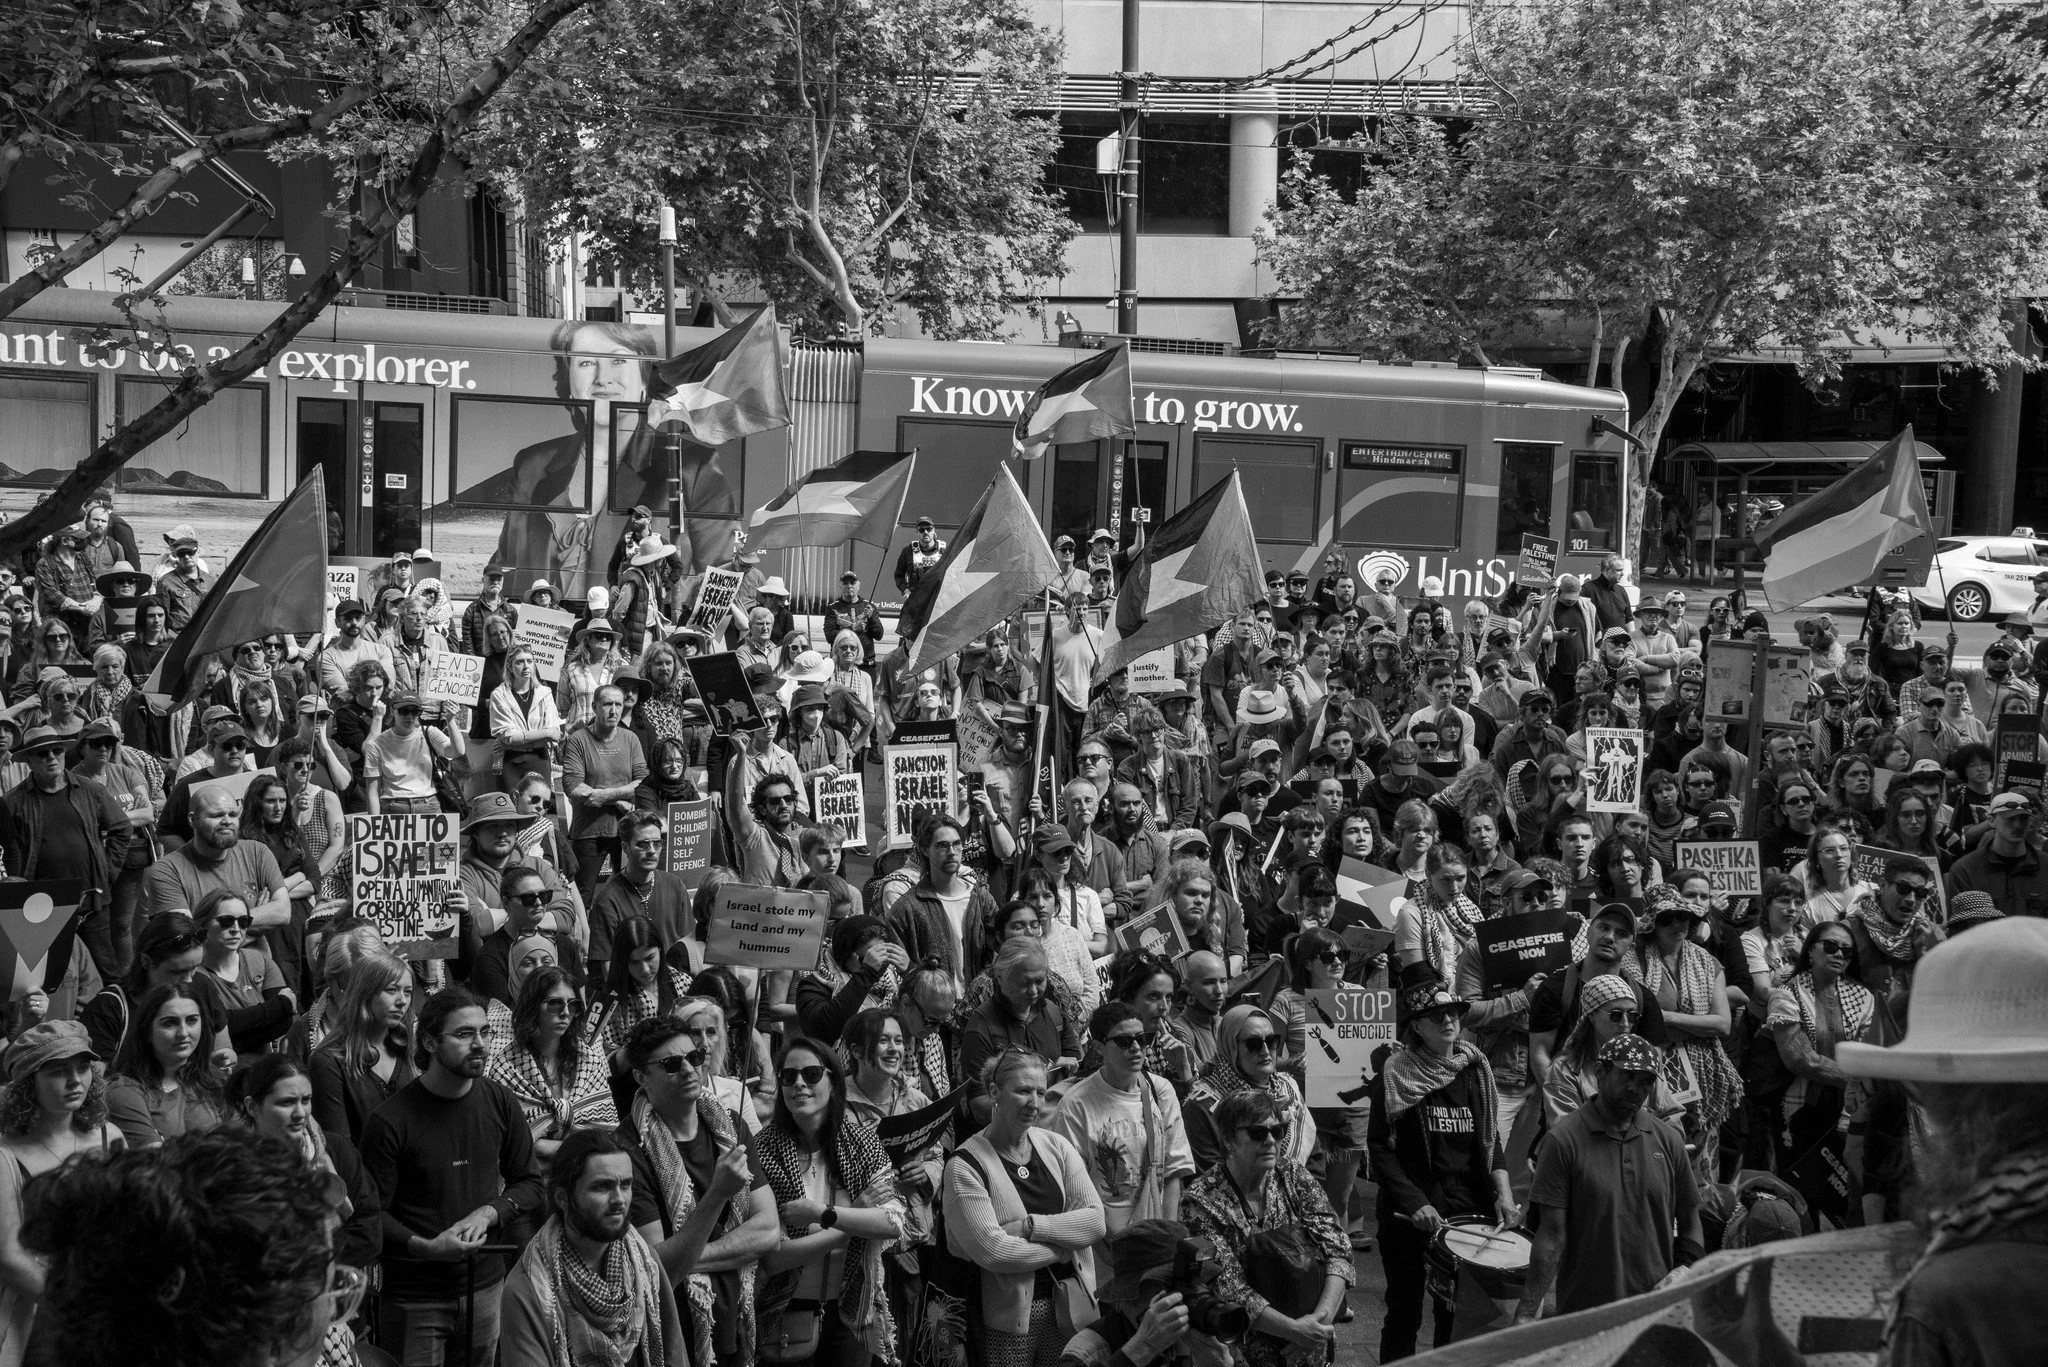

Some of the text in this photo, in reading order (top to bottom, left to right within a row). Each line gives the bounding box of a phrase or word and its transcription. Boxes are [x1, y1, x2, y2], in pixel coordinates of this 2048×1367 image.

[279, 345, 477, 392] explorer.
[1143, 391, 1186, 424] to
[1194, 398, 1303, 432] grow.
[1372, 455, 1430, 466] Hindmarsh
[1532, 543, 1549, 553] FREE
[1571, 539, 1589, 551] 101
[1522, 548, 1556, 561] PALESTINE
[327, 572, 356, 583] aza
[691, 605, 727, 629] NOW
[525, 630, 549, 642] WRONG
[541, 640, 564, 650] AFRICA
[437, 653, 478, 673] END
[535, 658, 554, 667] STINE
[1133, 663, 1159, 672] justify
[1134, 674, 1168, 682] another.
[428, 679, 480, 699] GENOCIDE
[900, 734, 951, 742] CEASEFIRE
[1587, 729, 1608, 737] PROTEST
[1618, 730, 1643, 739] PALESTINE
[2002, 733, 2035, 751] STOP
[965, 740, 979, 754] THE
[894, 754, 947, 774] SANCTION
[2001, 751, 2034, 763] ARMING
[819, 778, 858, 796] SANCTION
[895, 775, 948, 801] ISRAEL
[674, 808, 707, 821] BOMBING
[820, 795, 860, 817] ISRAEL
[354, 814, 449, 842] DEATH TO
[673, 820, 708, 834] CHILDREN
[673, 834, 700, 846] IS NOT
[355, 841, 446, 879] ISRAEL
[673, 848, 693, 859] SELF
[1681, 847, 1756, 869] PASIFIKA
[1860, 853, 1871, 864] IT
[673, 858, 706, 872] DEFENCE
[1709, 870, 1758, 892] ESTINE
[357, 880, 392, 900] OPEN
[392, 880, 405, 900] A
[355, 901, 453, 920] CORRIDOR FOR
[726, 900, 816, 919] Israel stole my
[380, 918, 425, 938] ESTINE
[730, 919, 806, 938] land and my
[738, 940, 791, 954] hummus
[1488, 932, 1565, 954] CEASEFIRE
[1518, 947, 1546, 960] NOW
[1334, 991, 1392, 1021] STOP
[1338, 1024, 1392, 1040] GENOCIDE
[881, 1106, 955, 1147] CEASEFIRE
[904, 1131, 931, 1154] NOW
